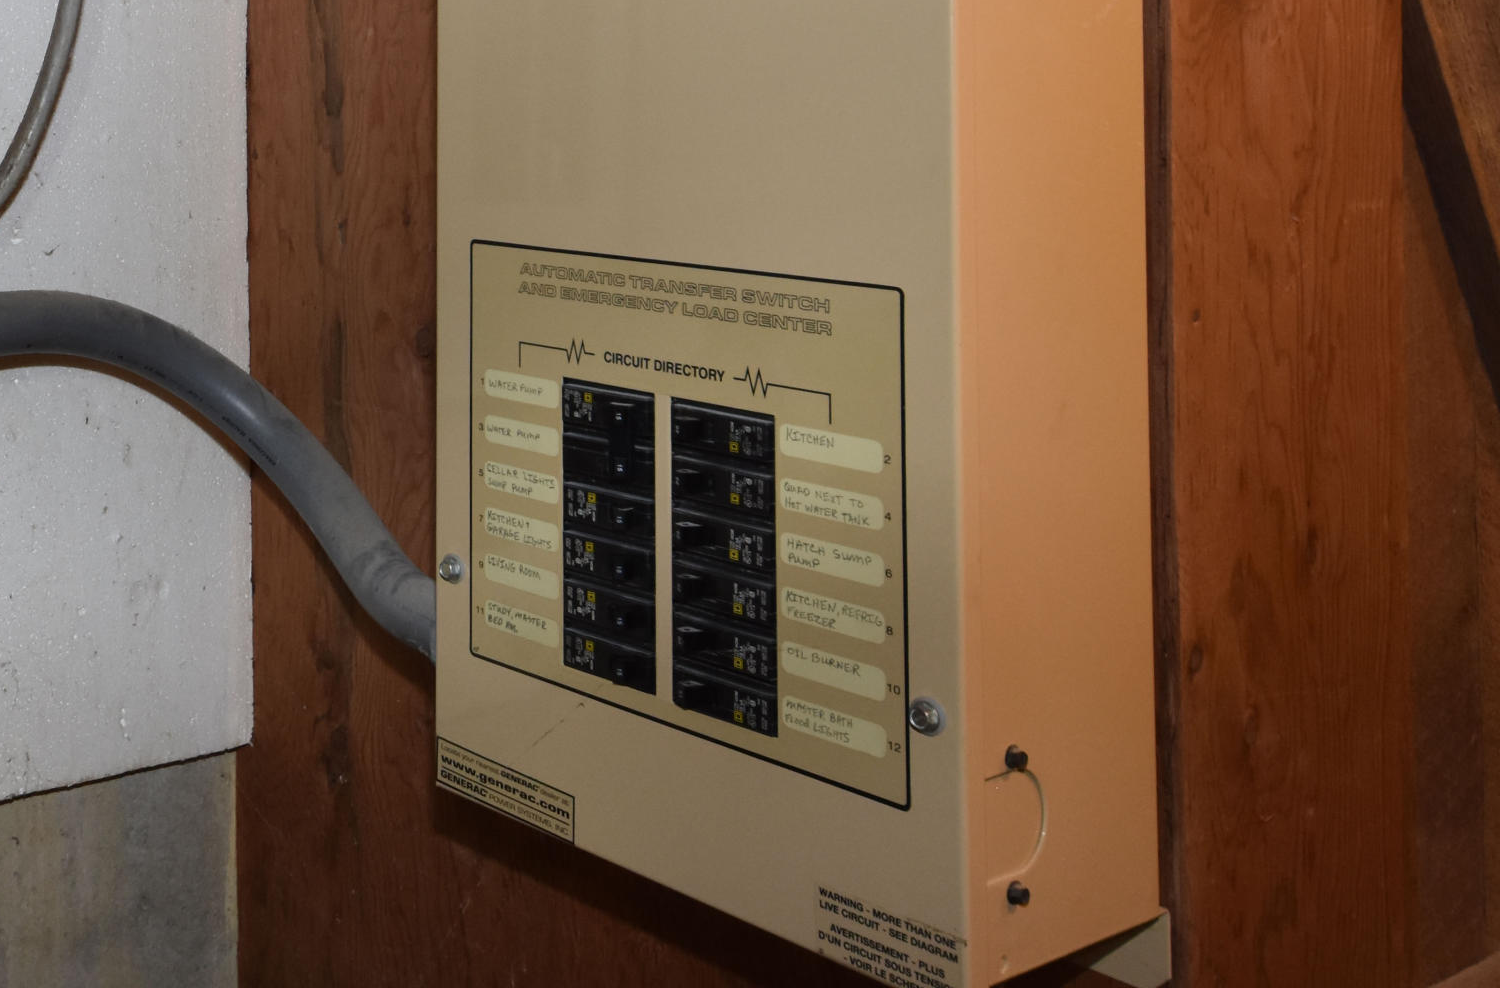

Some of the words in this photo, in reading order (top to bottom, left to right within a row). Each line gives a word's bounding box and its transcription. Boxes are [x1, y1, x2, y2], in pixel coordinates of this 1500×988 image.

[519, 262, 626, 287] AUTOMATIC
[629, 274, 737, 302] TRANSFER
[741, 289, 830, 314] SWITCH
[518, 281, 557, 298] AND
[560, 286, 678, 314] EMERGENCY
[682, 301, 739, 324] LOAD
[743, 311, 833, 336] CENTER
[603, 350, 651, 370] CIRCUIT
[654, 359, 725, 382] DIRECTORY
[488, 378, 518, 392] WATER
[479, 422, 484, 431] 3
[786, 426, 835, 448] KITCHEN
[884, 454, 891, 464] 2
[479, 468, 484, 477] 5
[486, 462, 519, 479] CELLAR
[784, 481, 811, 496] QUAD
[815, 490, 844, 506] NEXT
[849, 498, 864, 509] TO
[479, 514, 484, 523] 7
[487, 510, 525, 529] KITCHEN
[804, 503, 837, 519] WATER
[842, 512, 870, 526] TANK
[884, 511, 892, 521] 4
[486, 522, 520, 541] GARAGE
[523, 533, 552, 550] LIGHTS
[786, 537, 825, 555] HATCH
[479, 560, 484, 569] 9
[488, 555, 516, 572] LIVING
[885, 568, 893, 579] 6
[476, 605, 484, 614] 11
[487, 614, 503, 627] BED
[787, 606, 836, 630] FREEZER
[886, 626, 894, 636] 8
[787, 646, 807, 660] OIL
[811, 652, 861, 677] BURNER
[887, 683, 901, 695] 10
[786, 698, 826, 720] MASTER
[830, 712, 853, 728] BATH
[812, 721, 851, 743] LIGHTS
[888, 741, 901, 753] 12
[440, 769, 488, 797] GENERAC
[489, 793, 516, 811] POWER
[441, 755, 570, 820] www.generac.com
[500, 770, 539, 792] GENERAC
[819, 886, 864, 912] WARNING
[872, 907, 902, 927] MORE
[904, 920, 933, 940] THAN
[934, 933, 957, 950] ONE
[819, 899, 839, 915] LIVE
[841, 908, 880, 931] CIRCUIT
[888, 928, 909, 944] SEE
[910, 938, 959, 964] DIAGRAM
[818, 930, 842, 948] D'UN
[843, 941, 882, 967] CIRCUIT
[884, 958, 912, 978] SOUS
[830, 923, 910, 964] AVERTISSEMENT
[918, 961, 946, 979] PLUS
[849, 956, 873, 973] VOIR
[874, 966, 887, 980] LE
